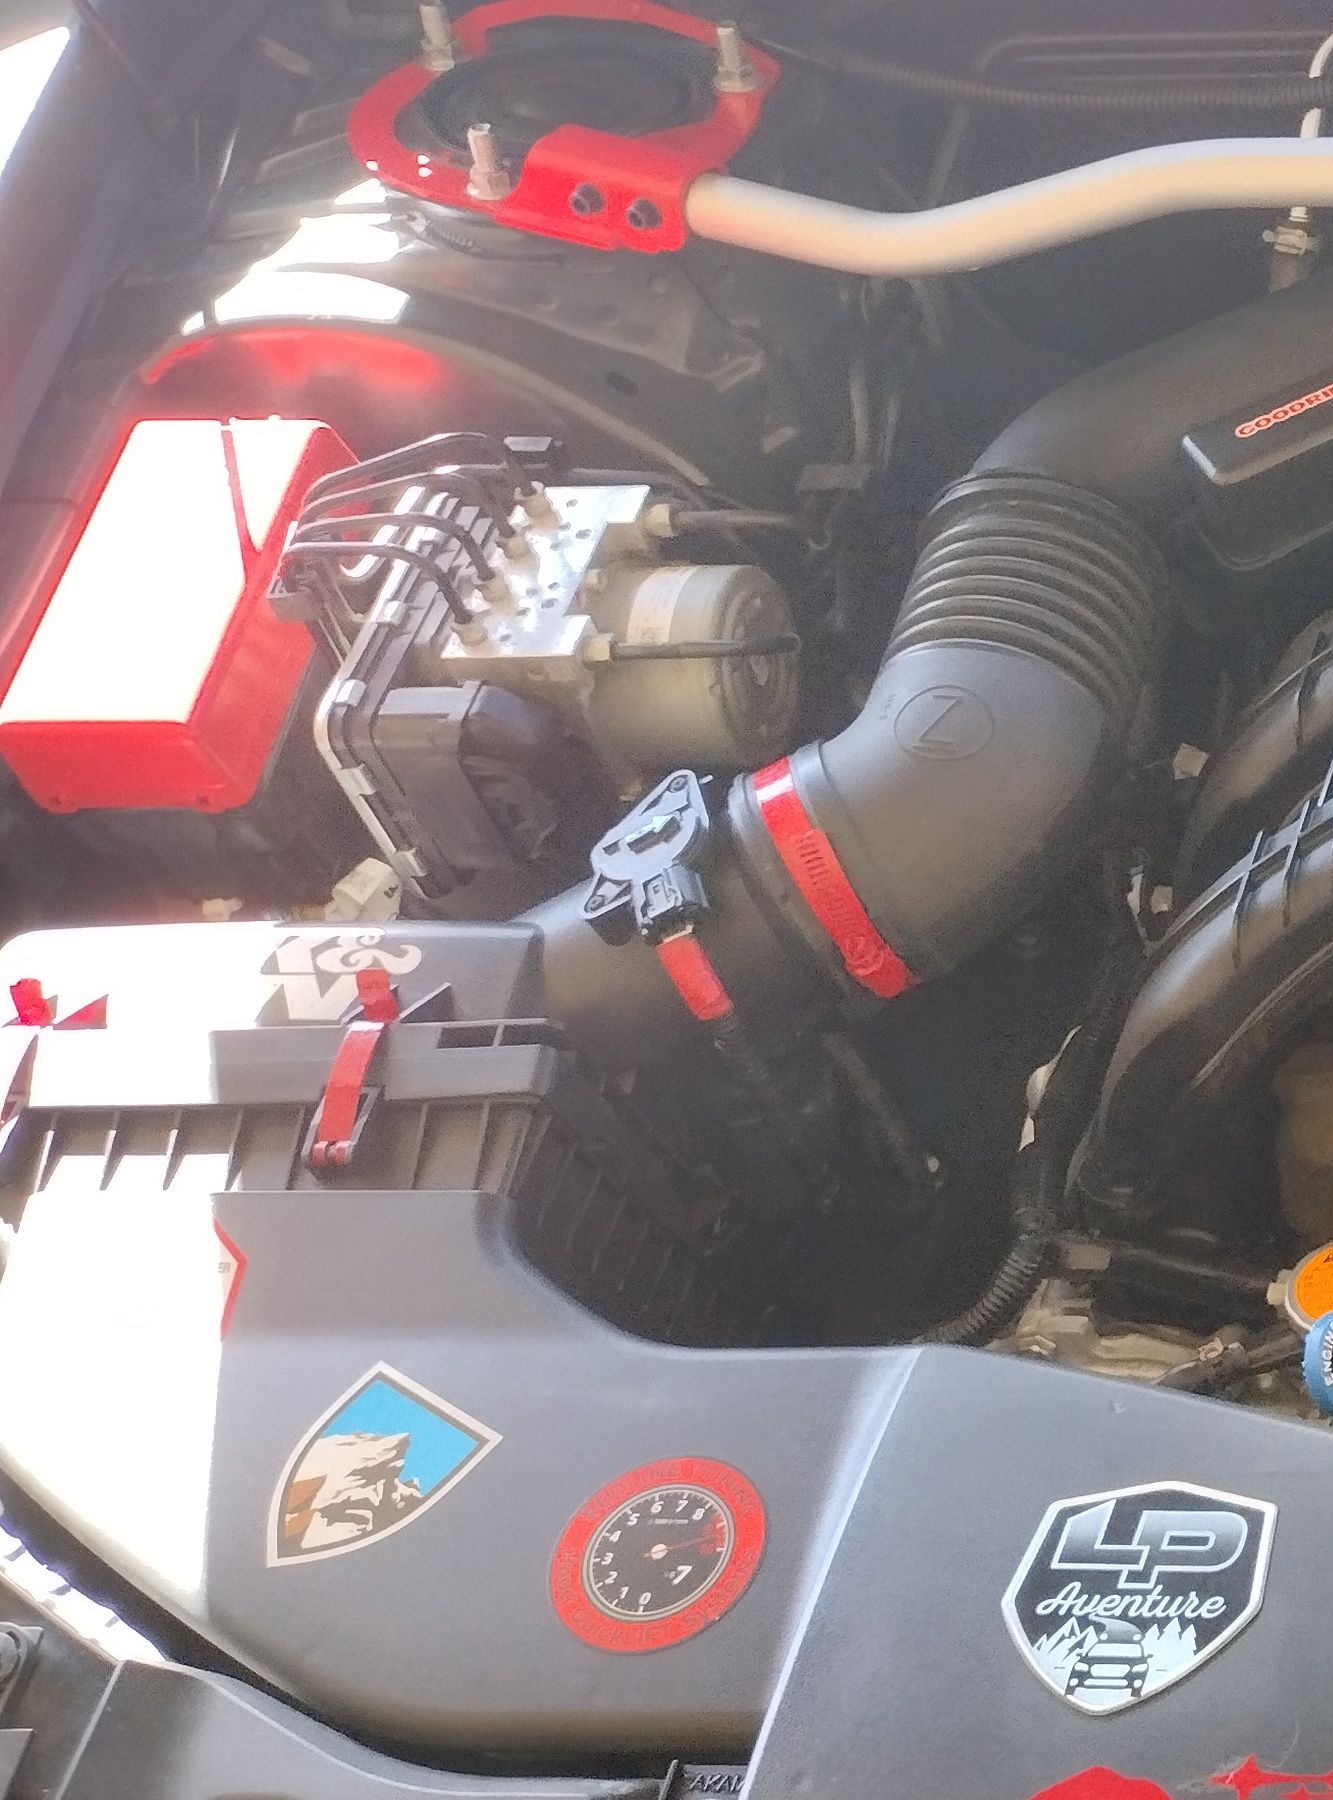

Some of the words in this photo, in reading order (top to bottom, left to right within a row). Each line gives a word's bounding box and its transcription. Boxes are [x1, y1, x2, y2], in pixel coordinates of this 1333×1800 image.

[651, 1501, 664, 1513] 6
[676, 1500, 688, 1512] 7
[628, 1513, 640, 1526] 5
[692, 1508, 705, 1520] 8
[609, 1531, 622, 1543] 4
[1050, 1499, 1248, 1589] LP
[602, 1553, 613, 1565] 3
[604, 1571, 617, 1584] 2
[620, 1587, 629, 1599] 1
[639, 1592, 651, 1605] 0
[1035, 1581, 1227, 1619] Aventure
